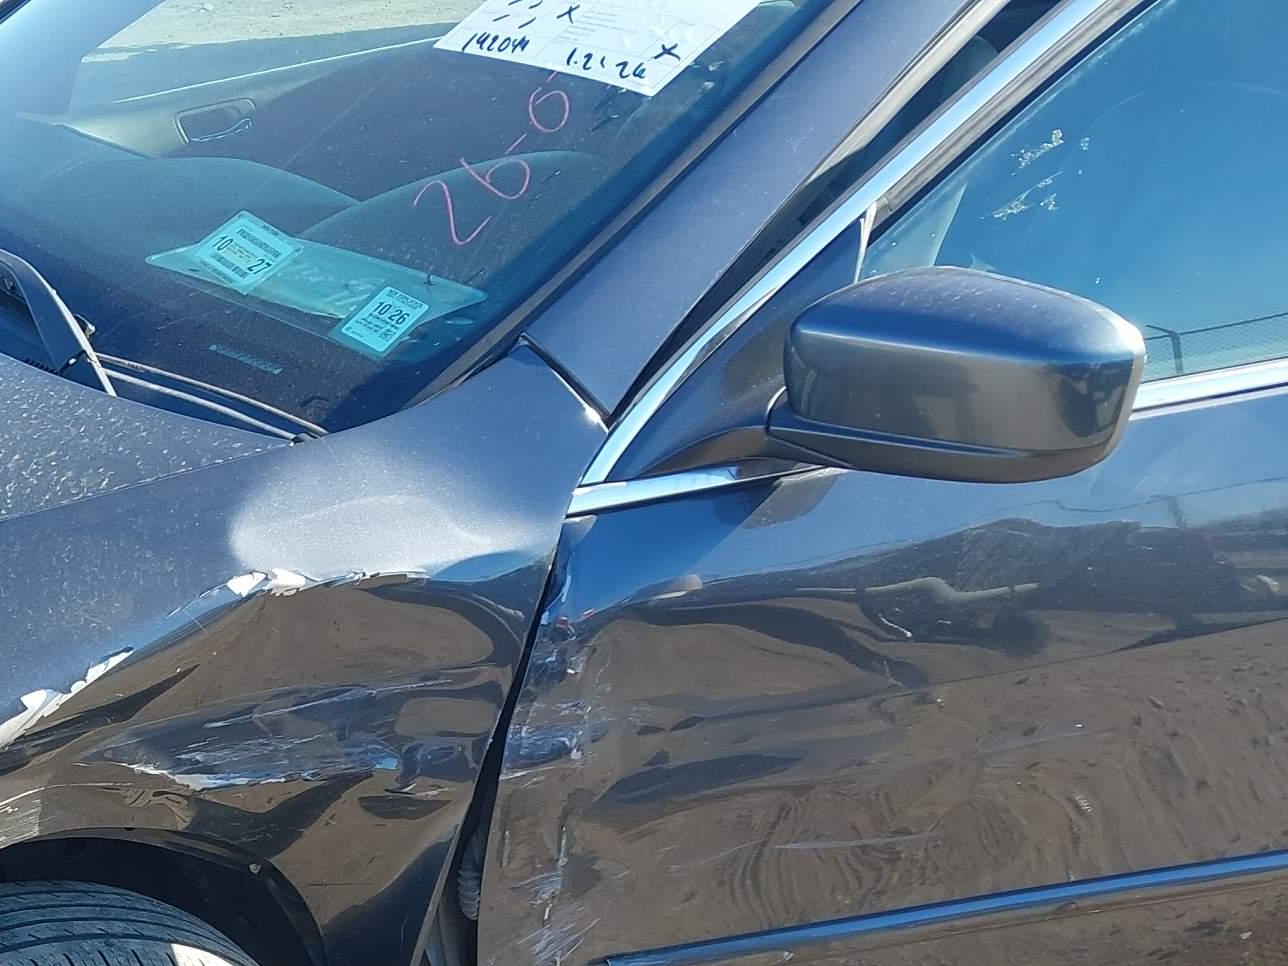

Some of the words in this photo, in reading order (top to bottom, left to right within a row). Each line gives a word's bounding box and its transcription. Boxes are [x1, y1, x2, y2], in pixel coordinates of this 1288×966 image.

[212, 235, 234, 251] 10
[247, 258, 273, 275] 27
[372, 301, 393, 316] 10
[388, 308, 411, 326] 26
